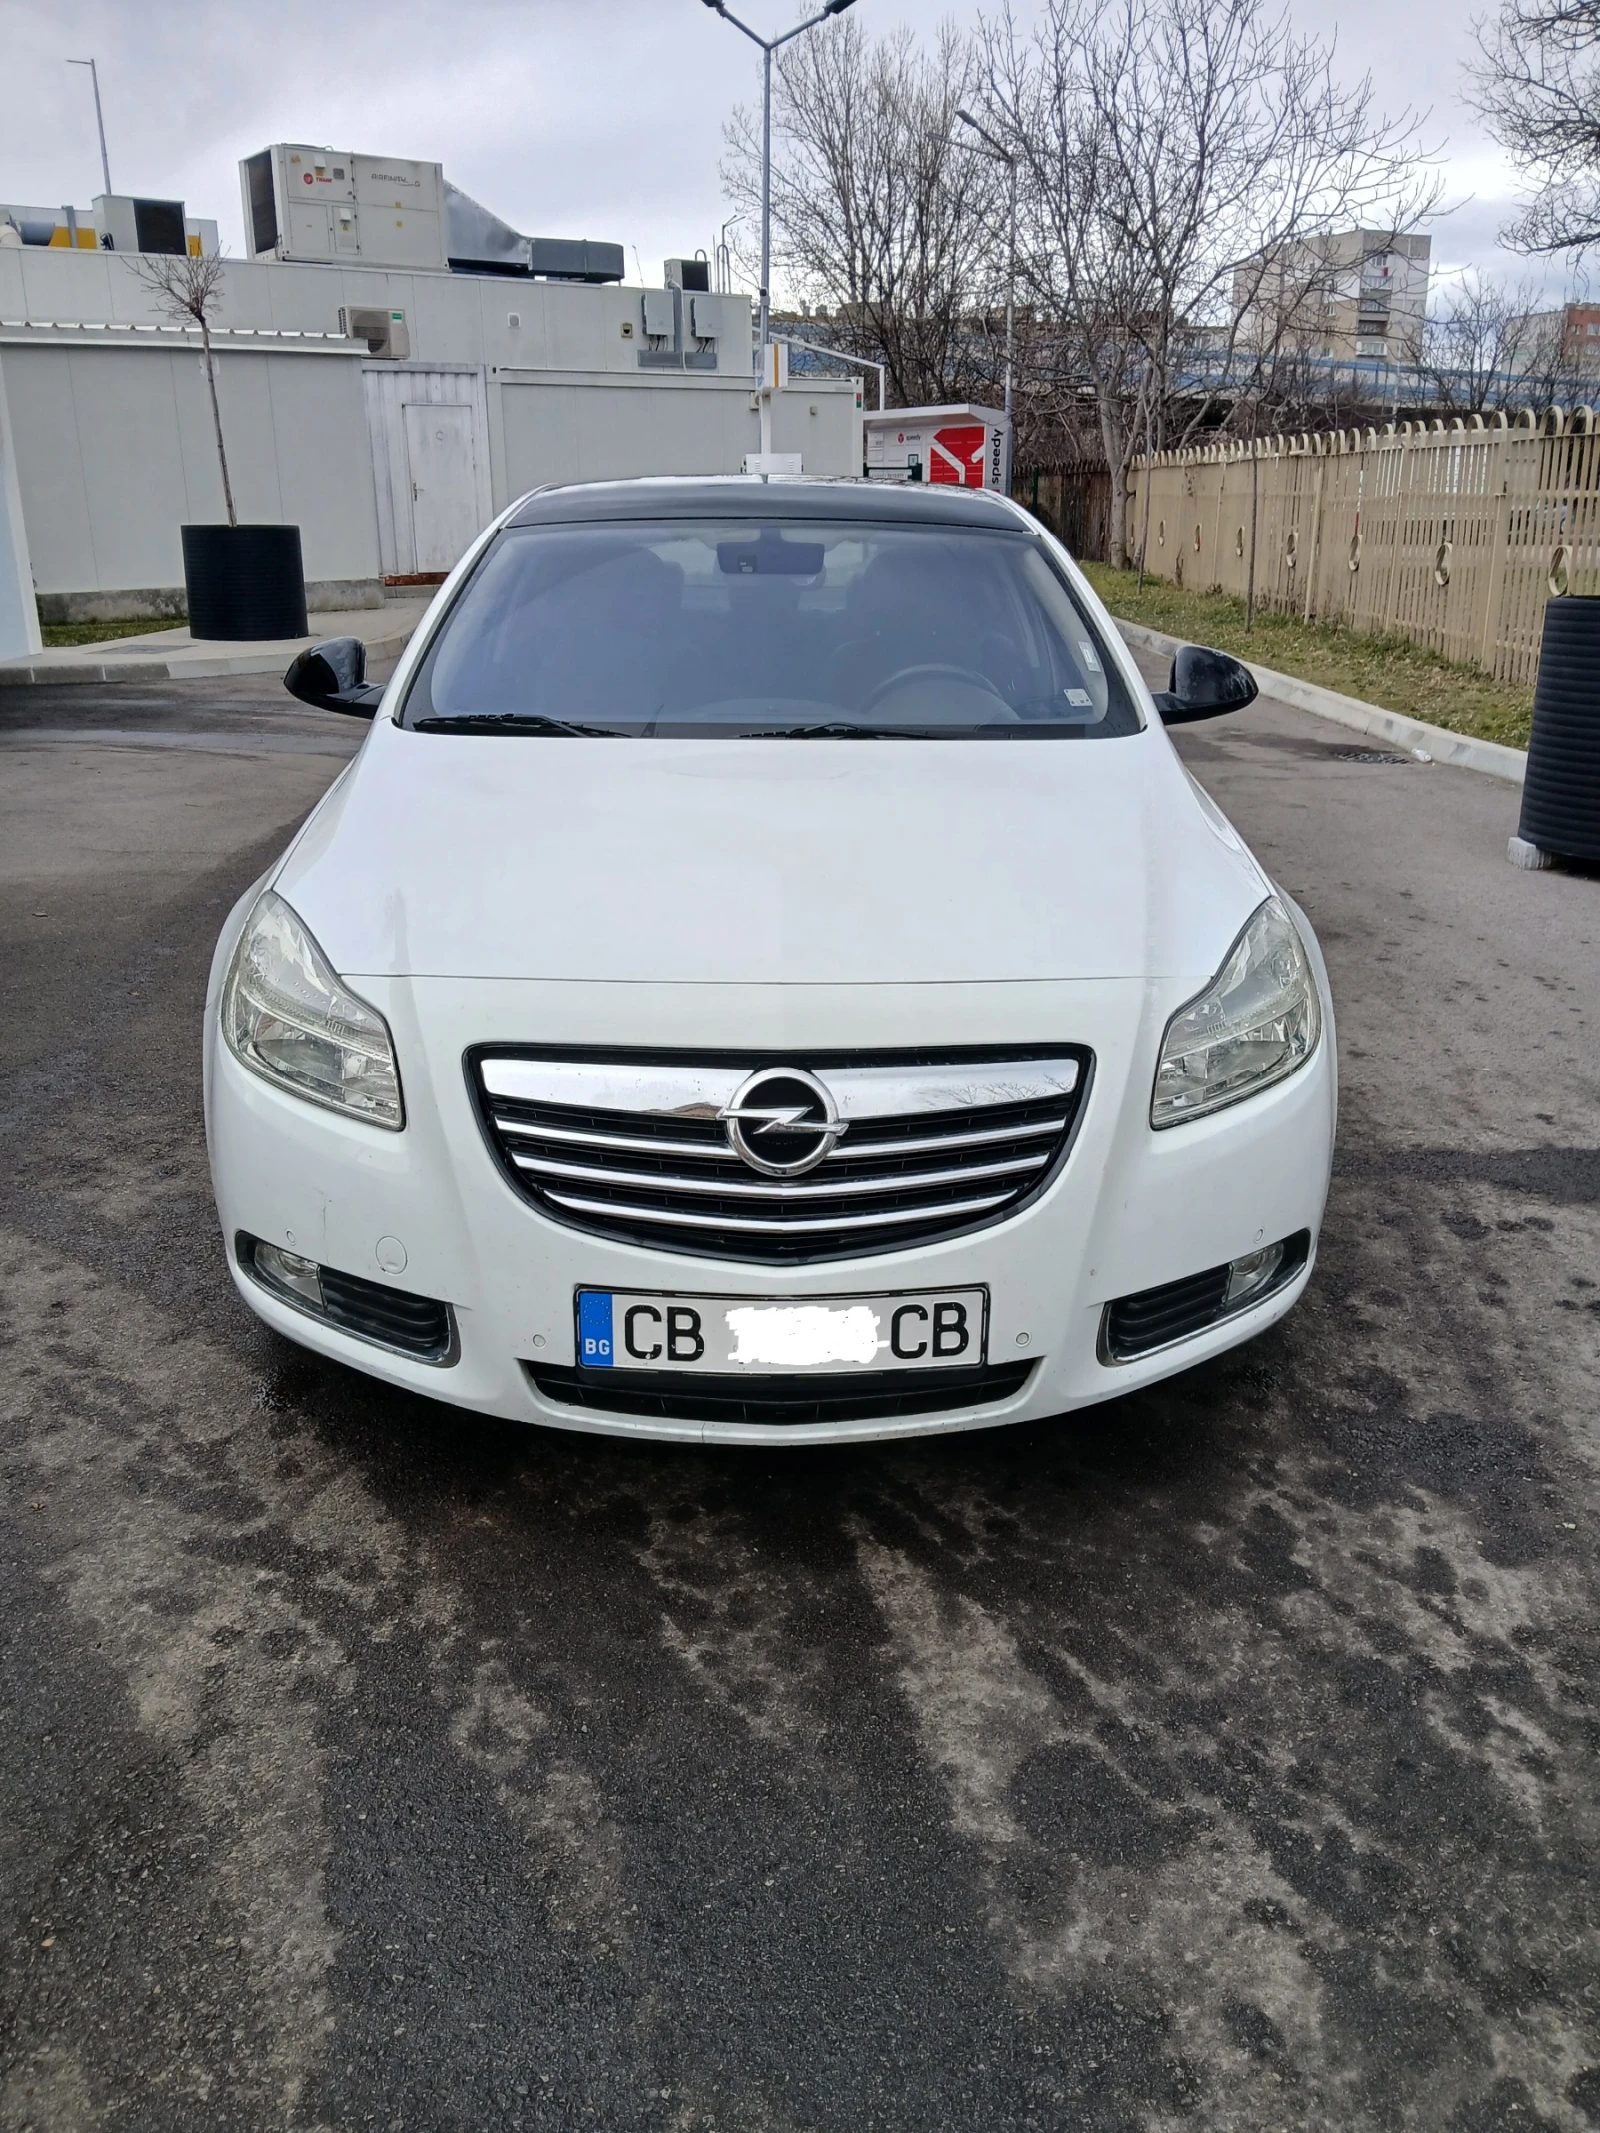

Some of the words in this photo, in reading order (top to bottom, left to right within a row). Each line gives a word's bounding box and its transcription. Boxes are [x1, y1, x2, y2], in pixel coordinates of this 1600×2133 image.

[906, 433, 922, 442] speedy
[991, 428, 1004, 485] speedy
[584, 1338, 610, 1355] BG
[624, 1304, 705, 1361] CB
[891, 1301, 970, 1358] CB
